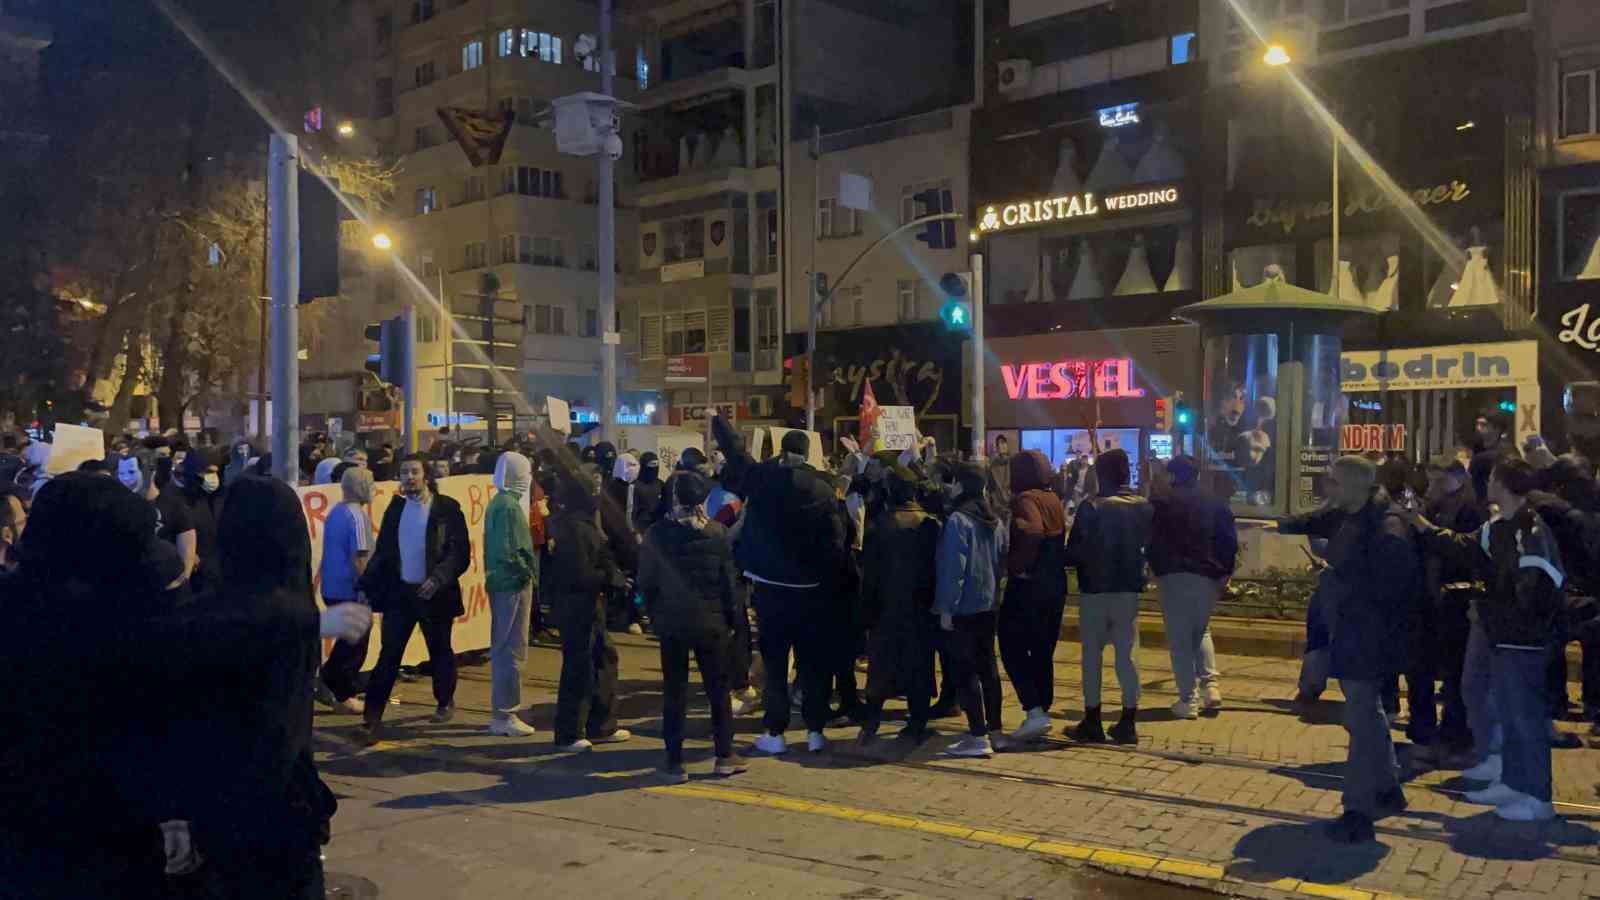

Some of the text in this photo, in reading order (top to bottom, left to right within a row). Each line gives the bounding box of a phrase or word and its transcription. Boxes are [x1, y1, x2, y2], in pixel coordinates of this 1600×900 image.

[1002, 188, 1178, 227] CRISTAL WEDDING
[1000, 356, 1145, 400] VESTEL
[683, 404, 734, 421] ECZNE
[1342, 424, 1405, 451] NDİRİM
